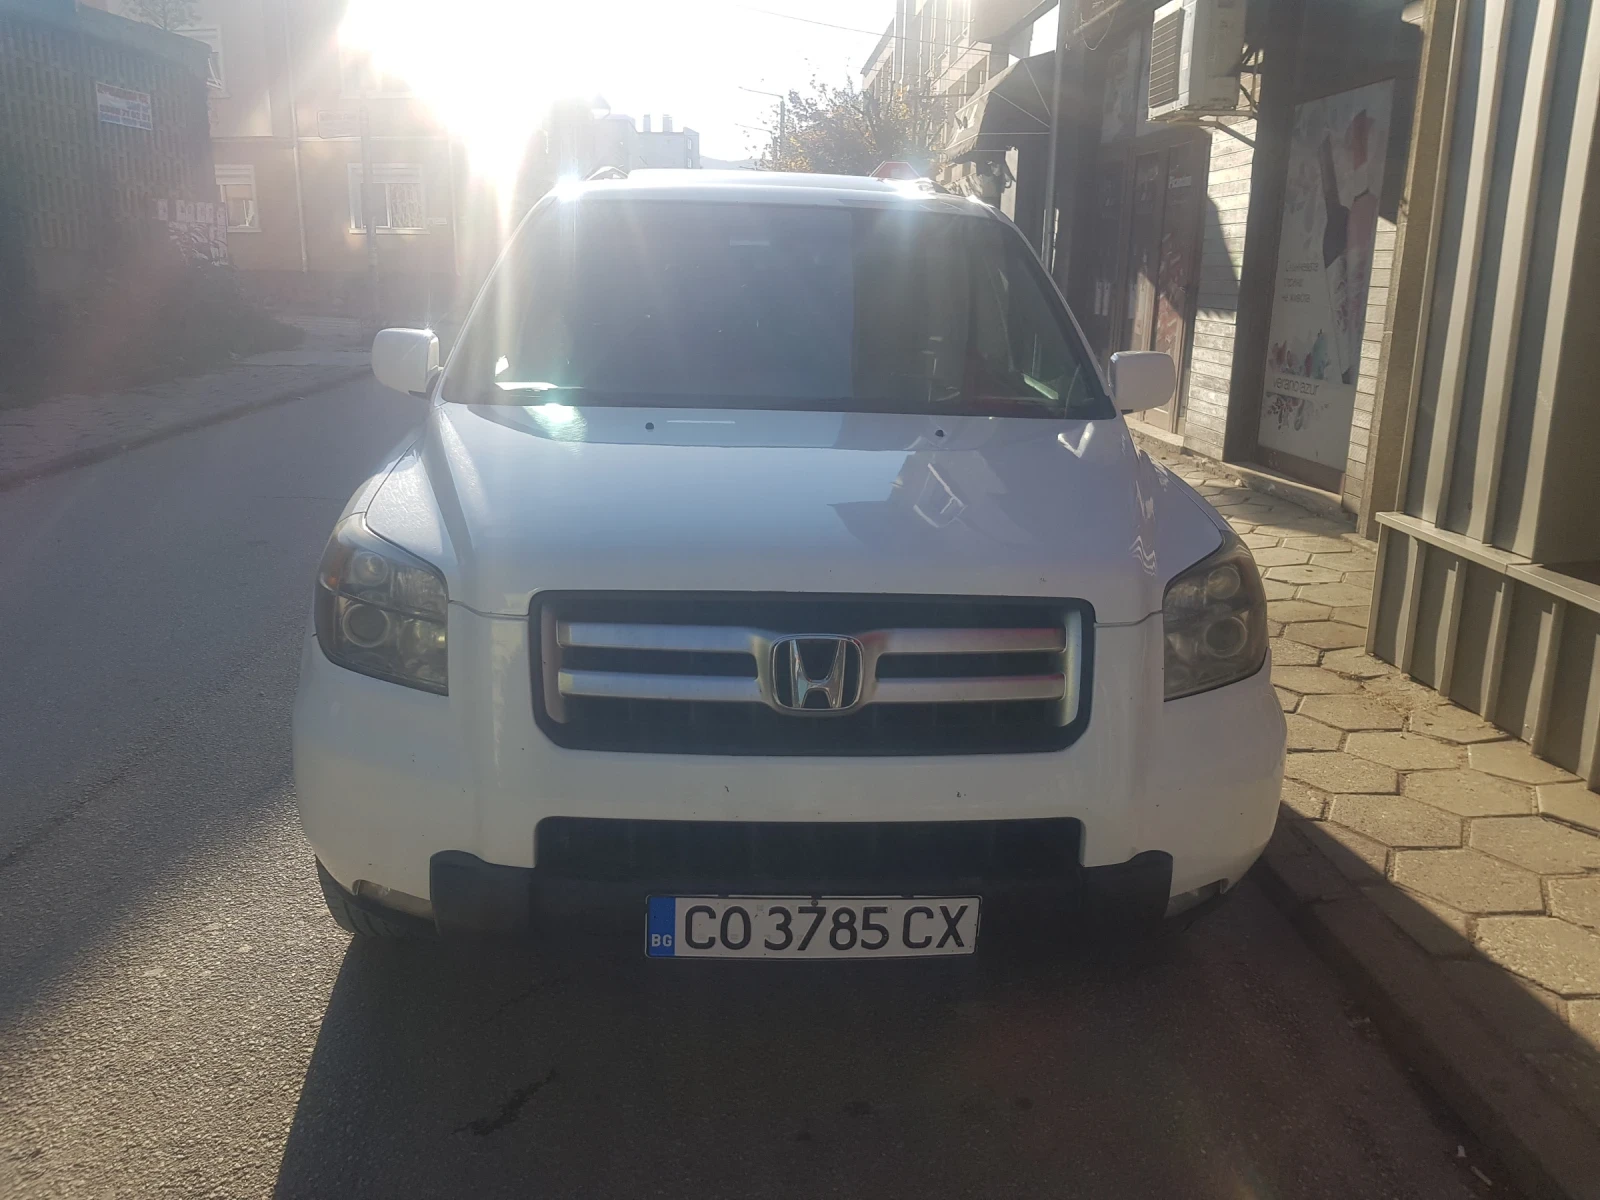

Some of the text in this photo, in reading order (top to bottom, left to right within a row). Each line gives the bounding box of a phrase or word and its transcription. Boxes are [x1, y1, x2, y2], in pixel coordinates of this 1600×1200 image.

[651, 905, 969, 951] BG CO 3785 CX
